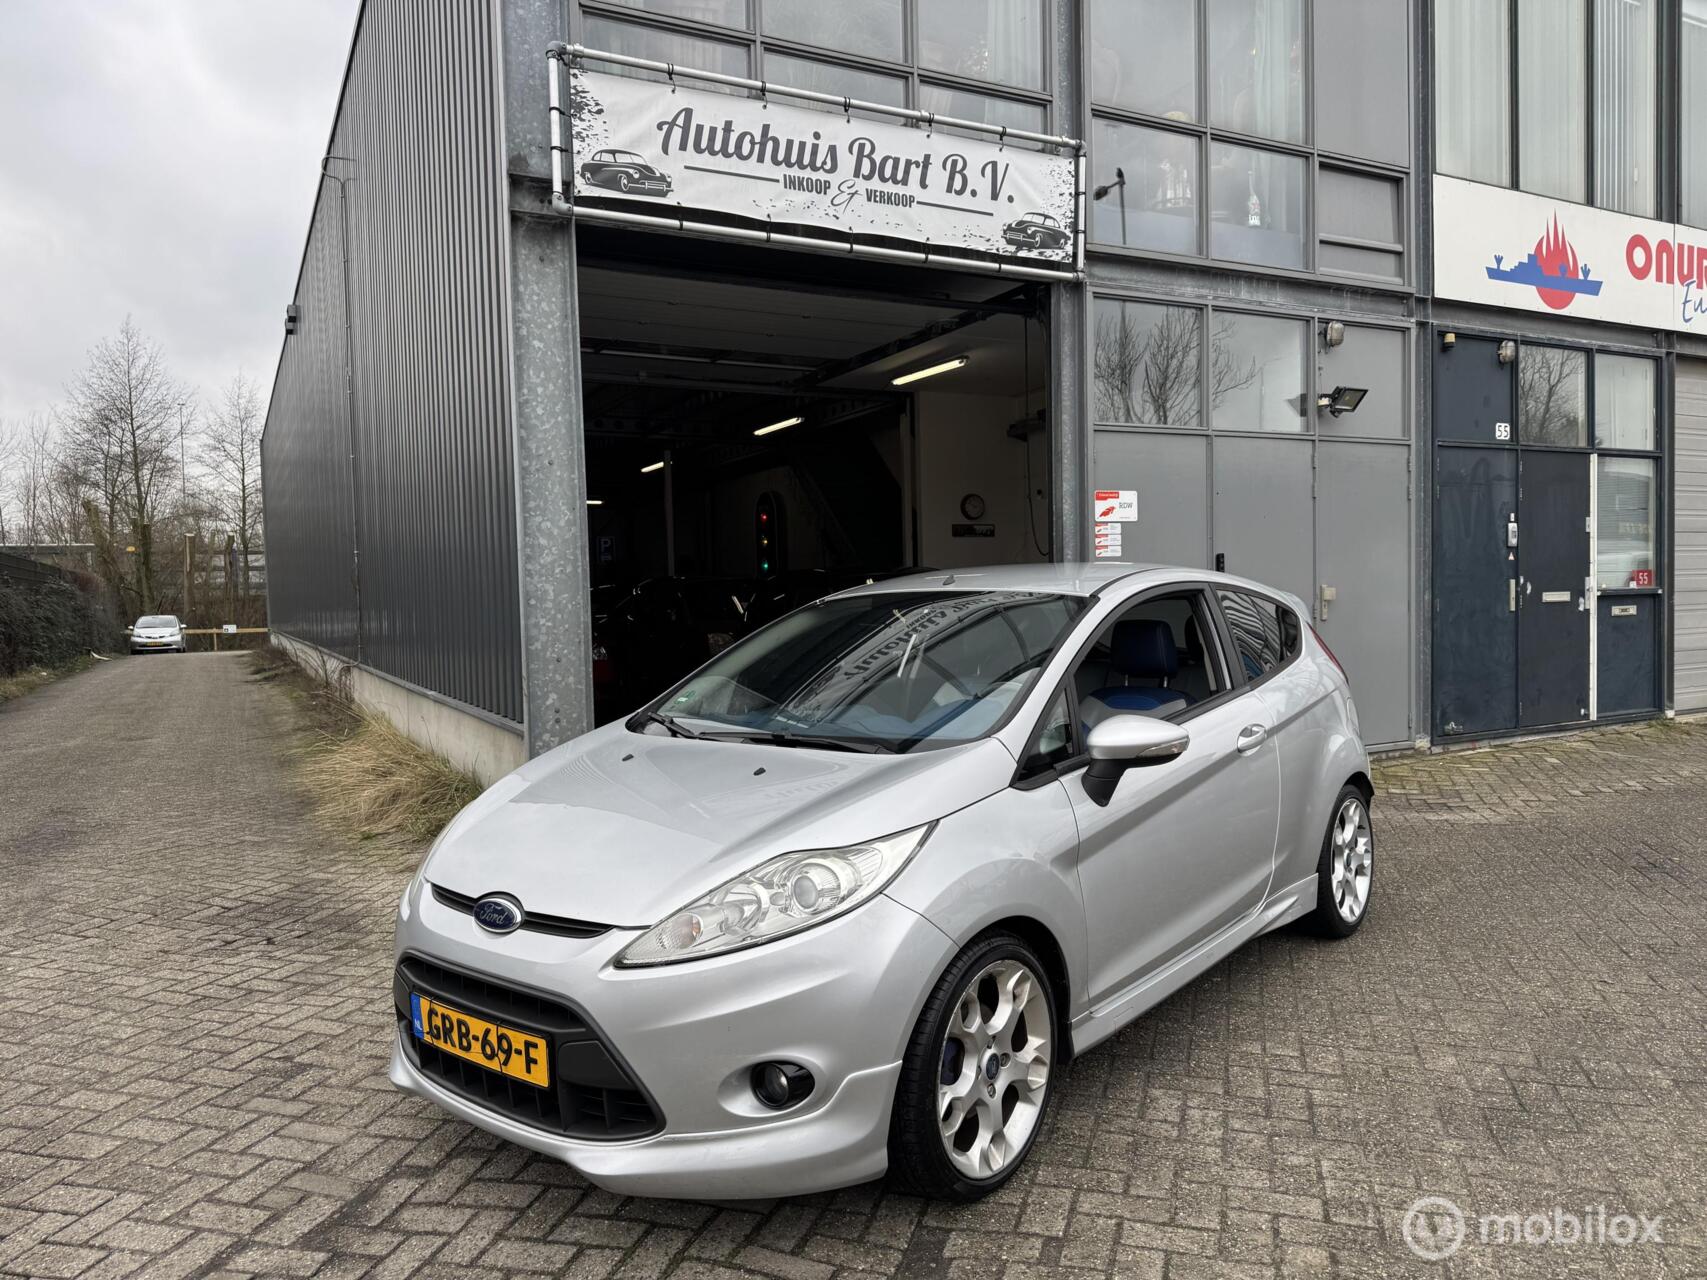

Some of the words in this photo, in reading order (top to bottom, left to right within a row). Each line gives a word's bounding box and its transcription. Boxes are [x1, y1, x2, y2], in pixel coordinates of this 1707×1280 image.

[656, 107, 838, 174] Autohuis
[847, 137, 933, 190] Bart
[942, 154, 1015, 204] B.V.
[782, 173, 831, 196] INKOOP
[865, 188, 916, 208] VERKOOP
[1497, 424, 1509, 438] 55
[1638, 572, 1649, 585] 55
[479, 903, 505, 925] Ford
[427, 1008, 539, 1075] GRB-69-F
